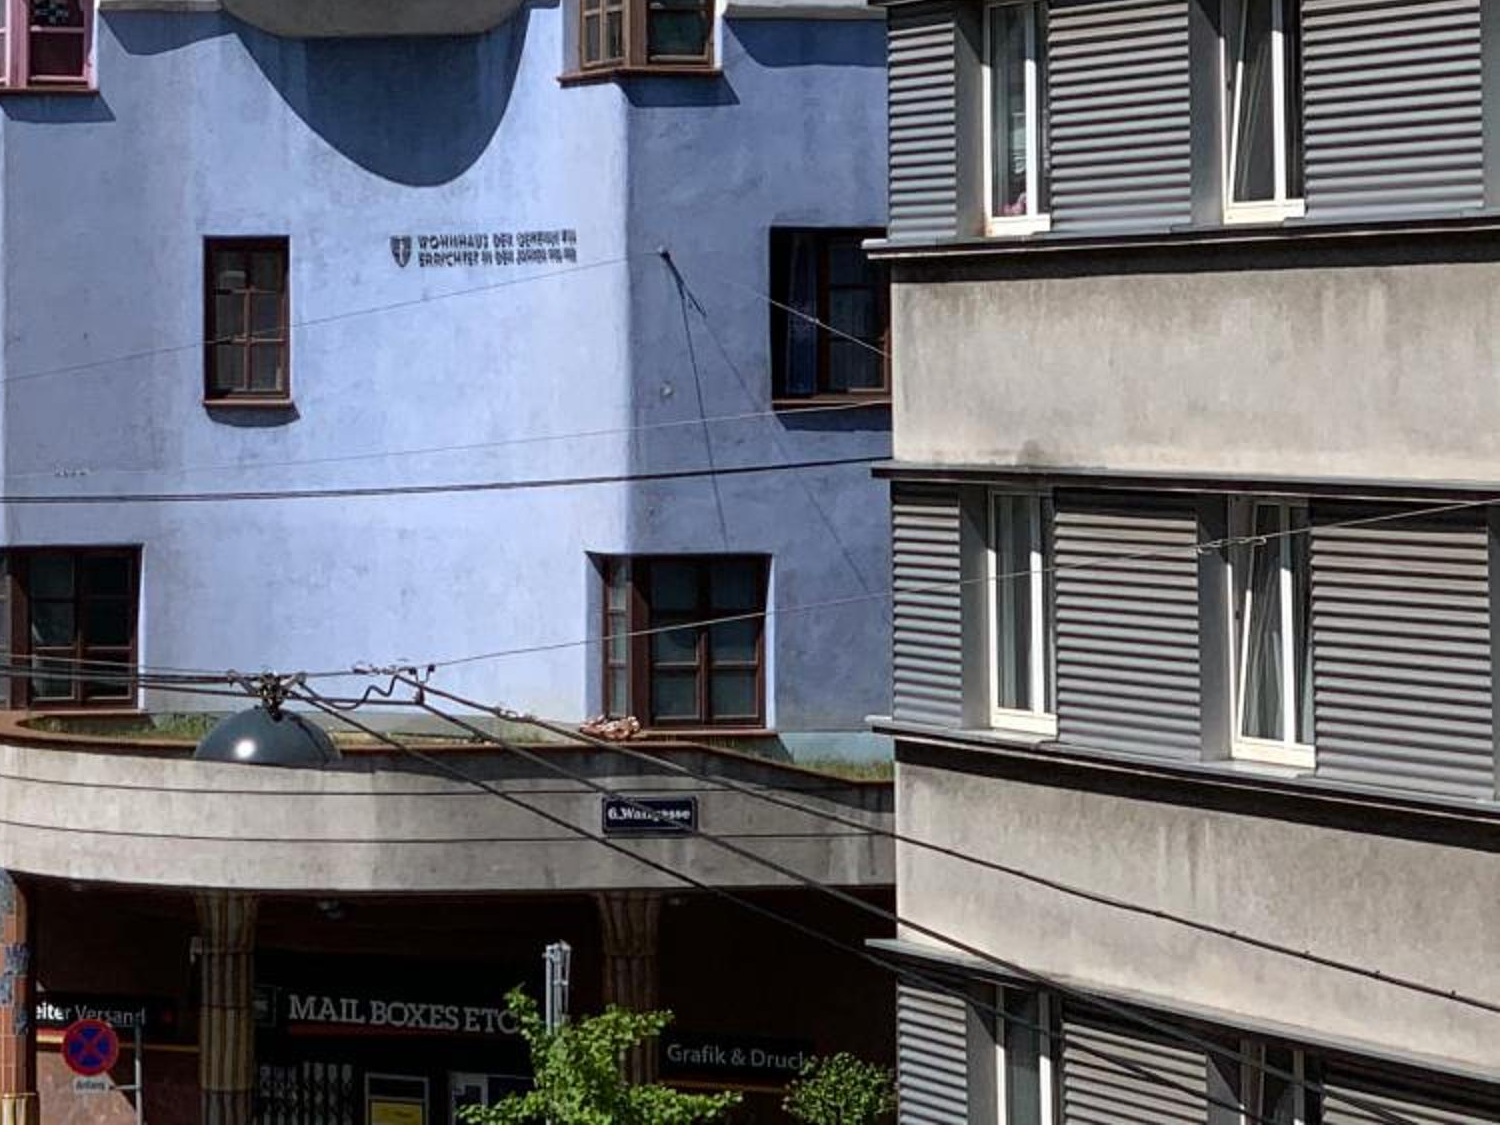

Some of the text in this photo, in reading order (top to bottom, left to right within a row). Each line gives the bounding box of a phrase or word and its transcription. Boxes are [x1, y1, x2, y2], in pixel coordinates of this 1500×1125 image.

[76, 1004, 146, 1026] Versand
[289, 994, 365, 1023] MAIL
[369, 999, 460, 1030] BOXES
[667, 1043, 727, 1065] Grafik
[731, 1048, 747, 1066] &
